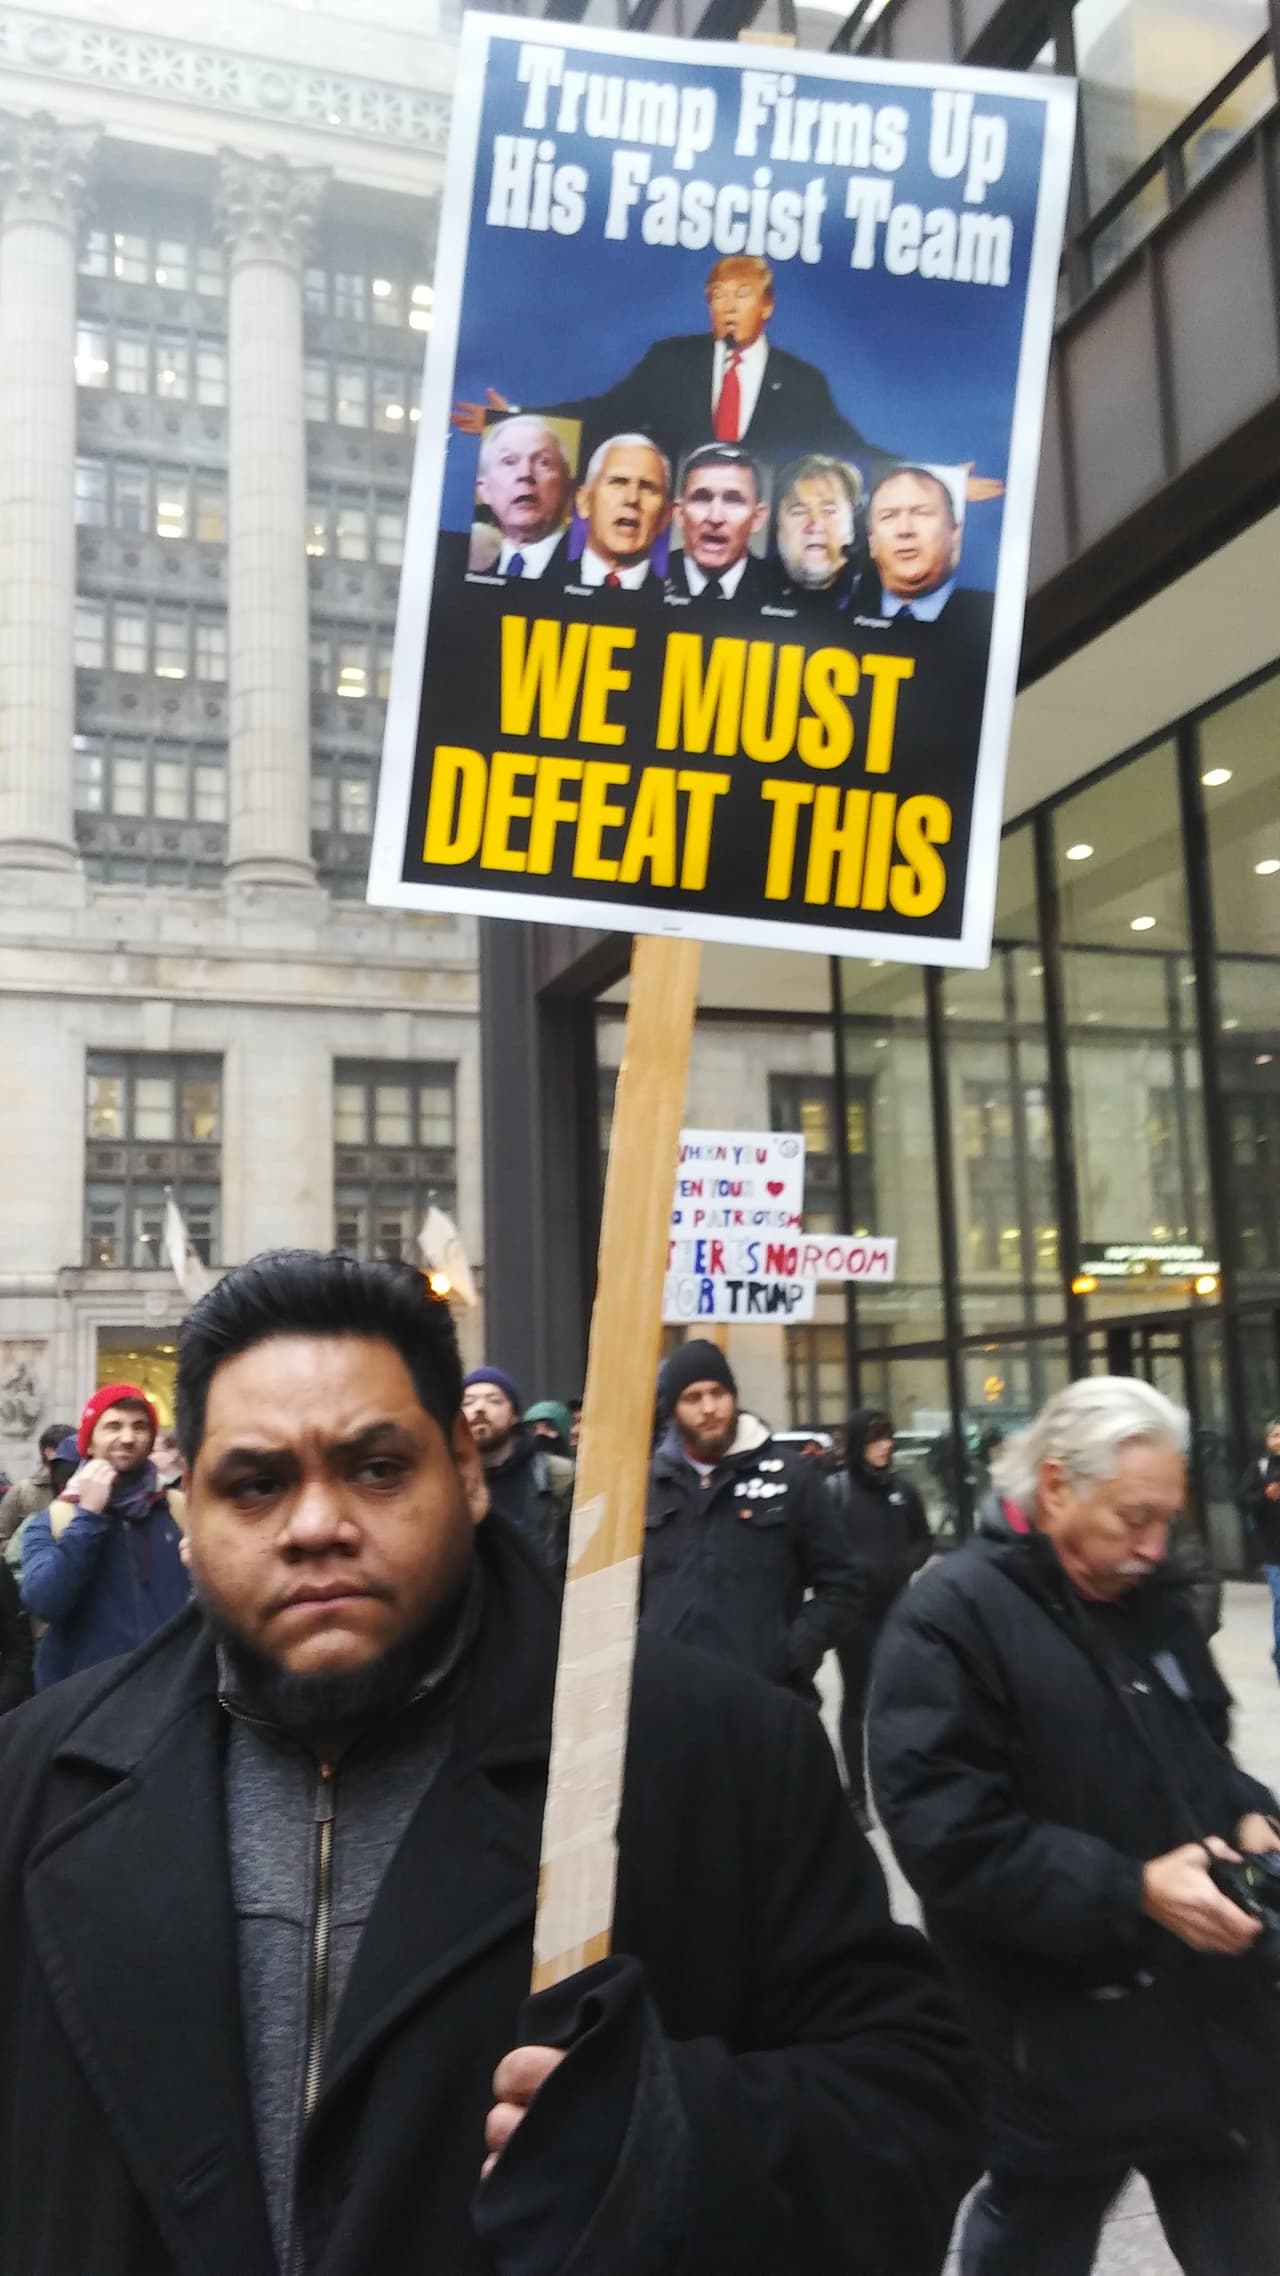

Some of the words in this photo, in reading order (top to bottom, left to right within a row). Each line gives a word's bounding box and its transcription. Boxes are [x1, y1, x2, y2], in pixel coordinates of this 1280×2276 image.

[518, 43, 717, 170] Trump
[735, 70, 908, 172] Firms
[929, 91, 1008, 203] Up
[486, 135, 587, 235] His
[605, 150, 827, 264] Fascist
[844, 177, 1013, 287] Team
[500, 614, 636, 745] WE
[657, 631, 915, 774] MUST
[422, 745, 731, 890] DEFEAT
[761, 779, 952, 918] THIS
